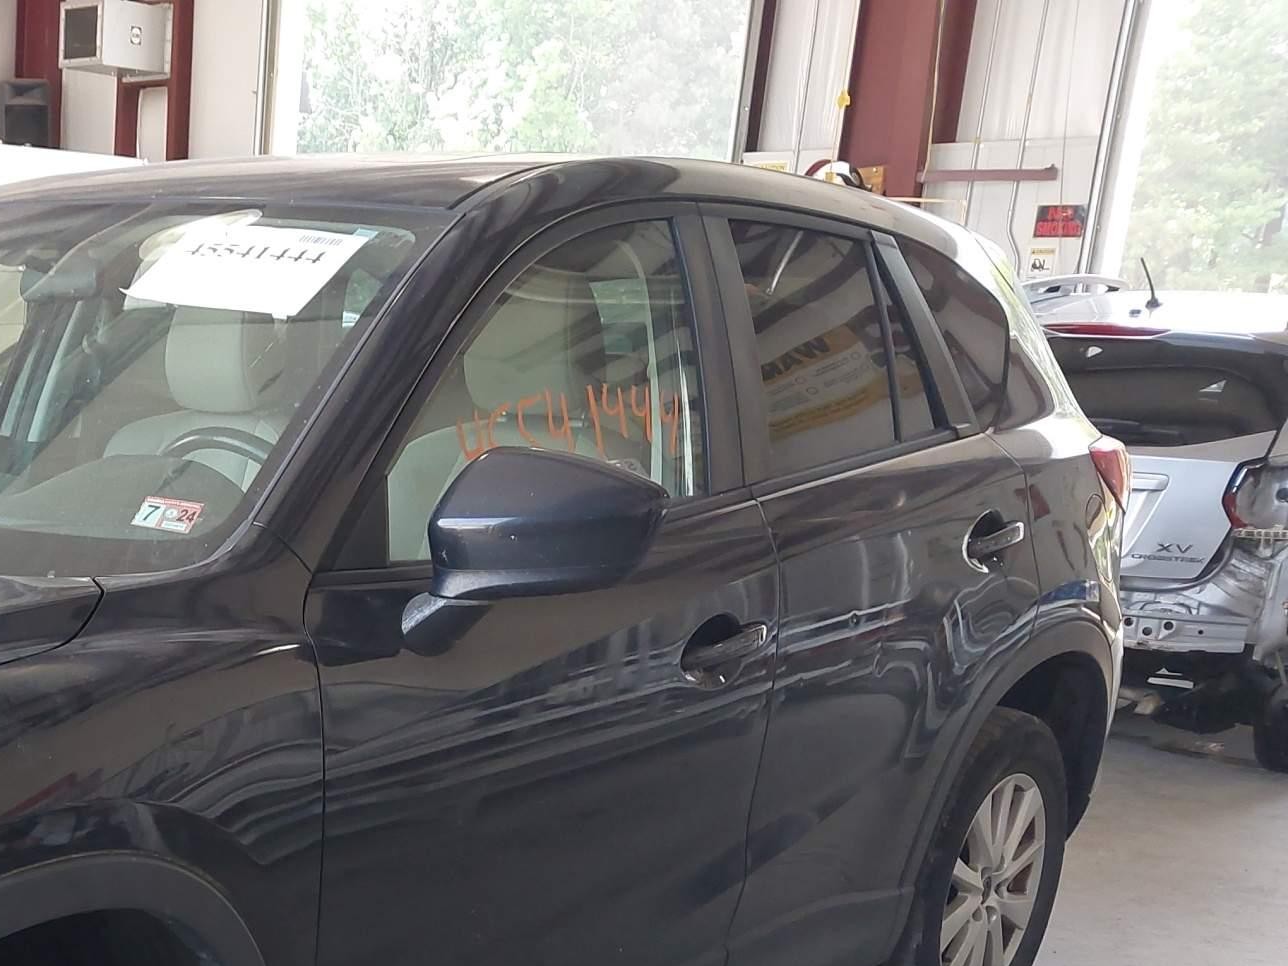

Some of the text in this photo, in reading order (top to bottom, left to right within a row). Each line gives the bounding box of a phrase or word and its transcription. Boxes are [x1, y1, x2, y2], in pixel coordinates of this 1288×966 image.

[143, 504, 161, 521] 7
[176, 508, 198, 523] 24
[1156, 543, 1194, 554] XV
